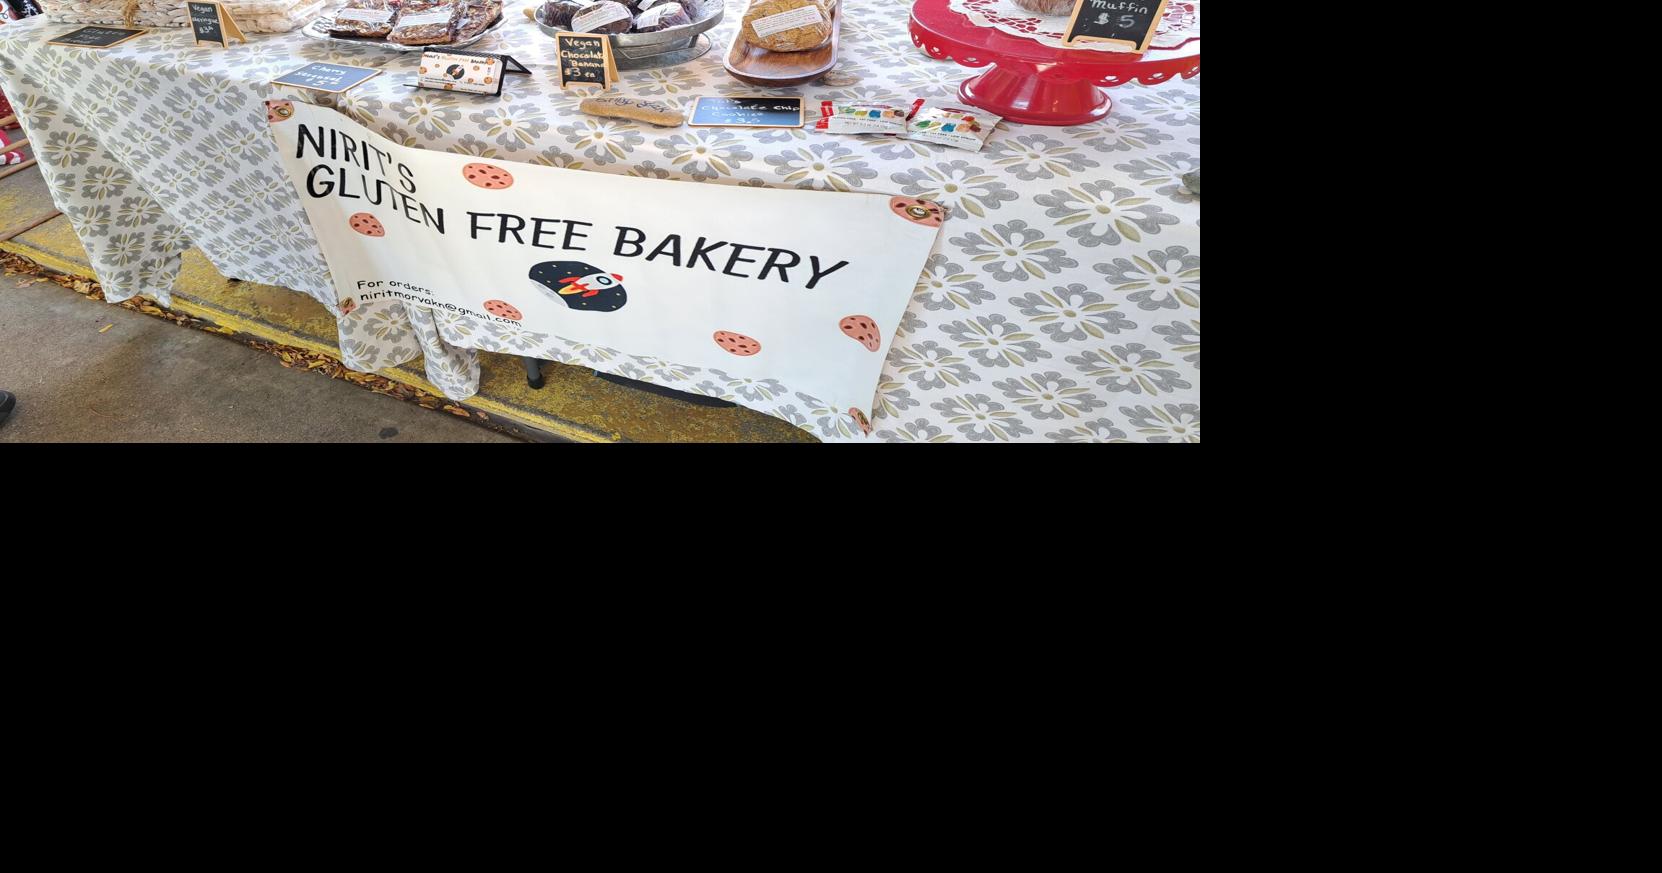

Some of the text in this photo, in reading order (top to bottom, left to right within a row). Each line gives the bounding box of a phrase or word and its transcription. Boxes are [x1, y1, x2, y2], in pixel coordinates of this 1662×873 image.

[564, 38, 600, 50] Vegan
[295, 123, 417, 194] NIRIT'S
[306, 164, 850, 290] GLUTEN FREE BAKERY
[357, 279, 435, 296] For orders:
[360, 290, 522, 328] niritmorvakn@gmail.com
